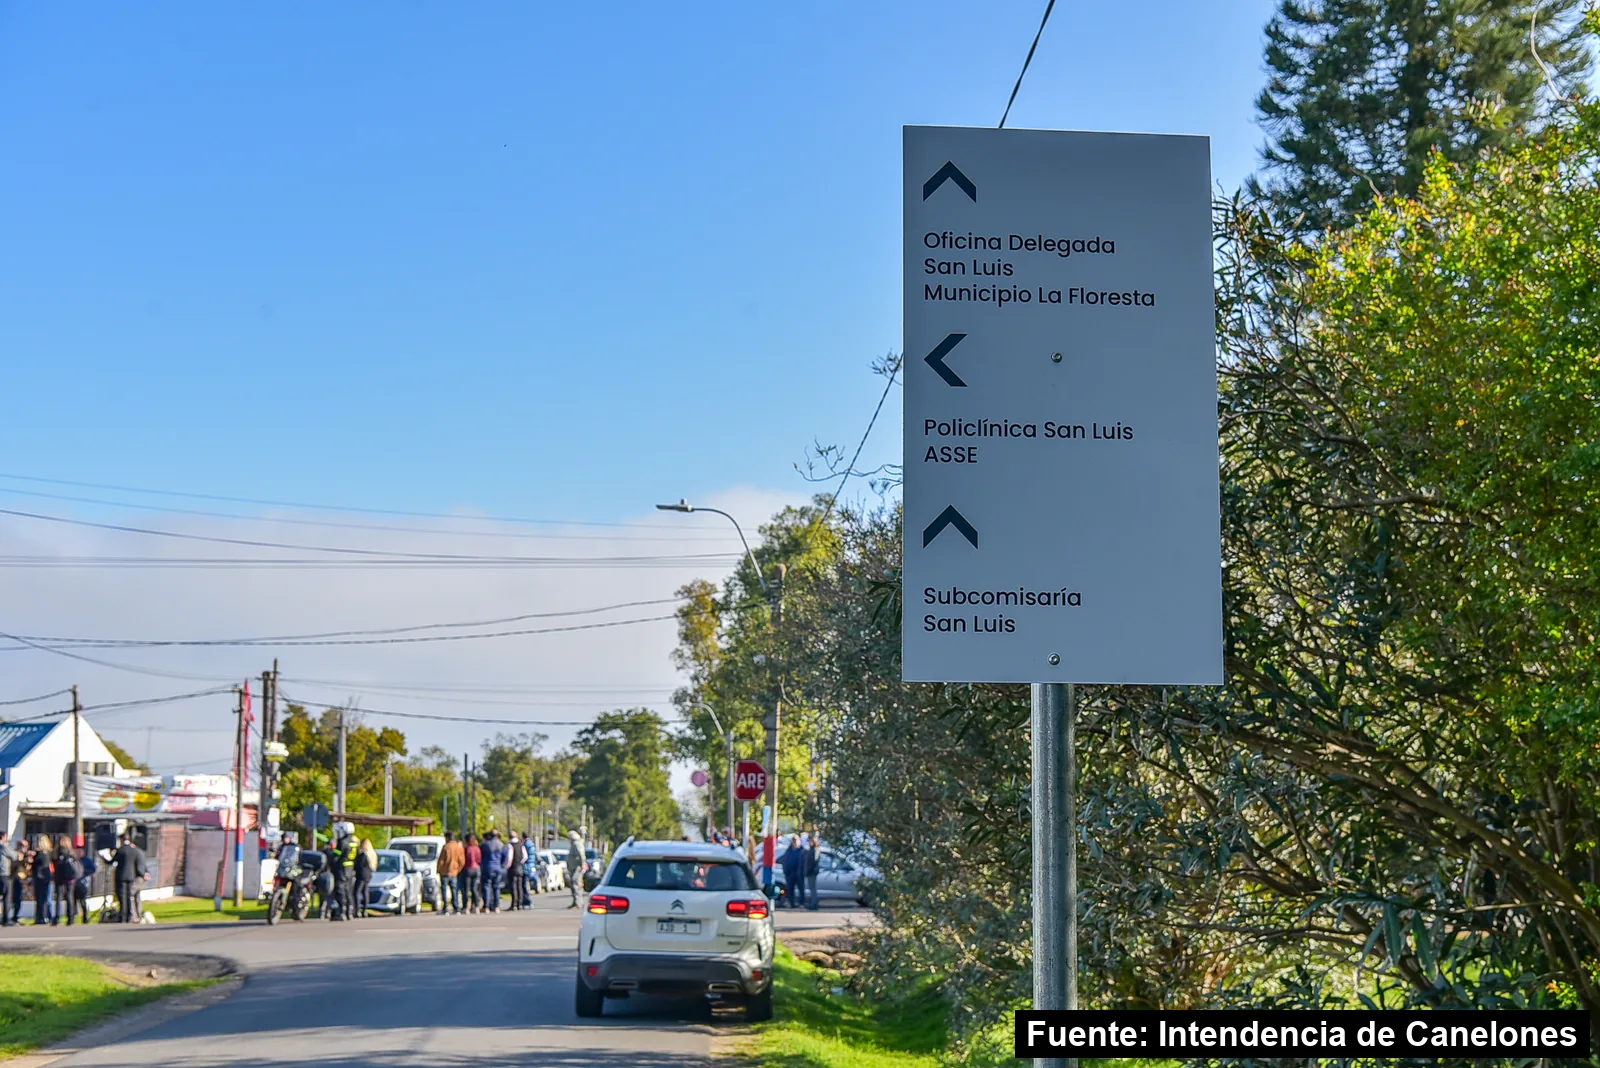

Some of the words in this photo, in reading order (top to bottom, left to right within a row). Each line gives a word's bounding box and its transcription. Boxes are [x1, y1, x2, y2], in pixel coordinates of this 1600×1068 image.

[923, 231, 1002, 251] Oficina
[1009, 234, 1115, 258] Delegada
[924, 257, 966, 276] San
[973, 258, 1014, 277] Luis
[924, 283, 1032, 308] Municipio
[1038, 286, 1062, 304] La
[1069, 287, 1156, 307] Floresta
[924, 418, 1037, 438] Policlínica
[1044, 421, 1086, 439] San
[1092, 421, 1134, 440] Luis
[923, 445, 978, 464] ASSE
[923, 586, 1082, 607] Subcomisaría
[923, 614, 966, 633] San
[974, 613, 1016, 633] Luis
[735, 772, 765, 789] ARE
